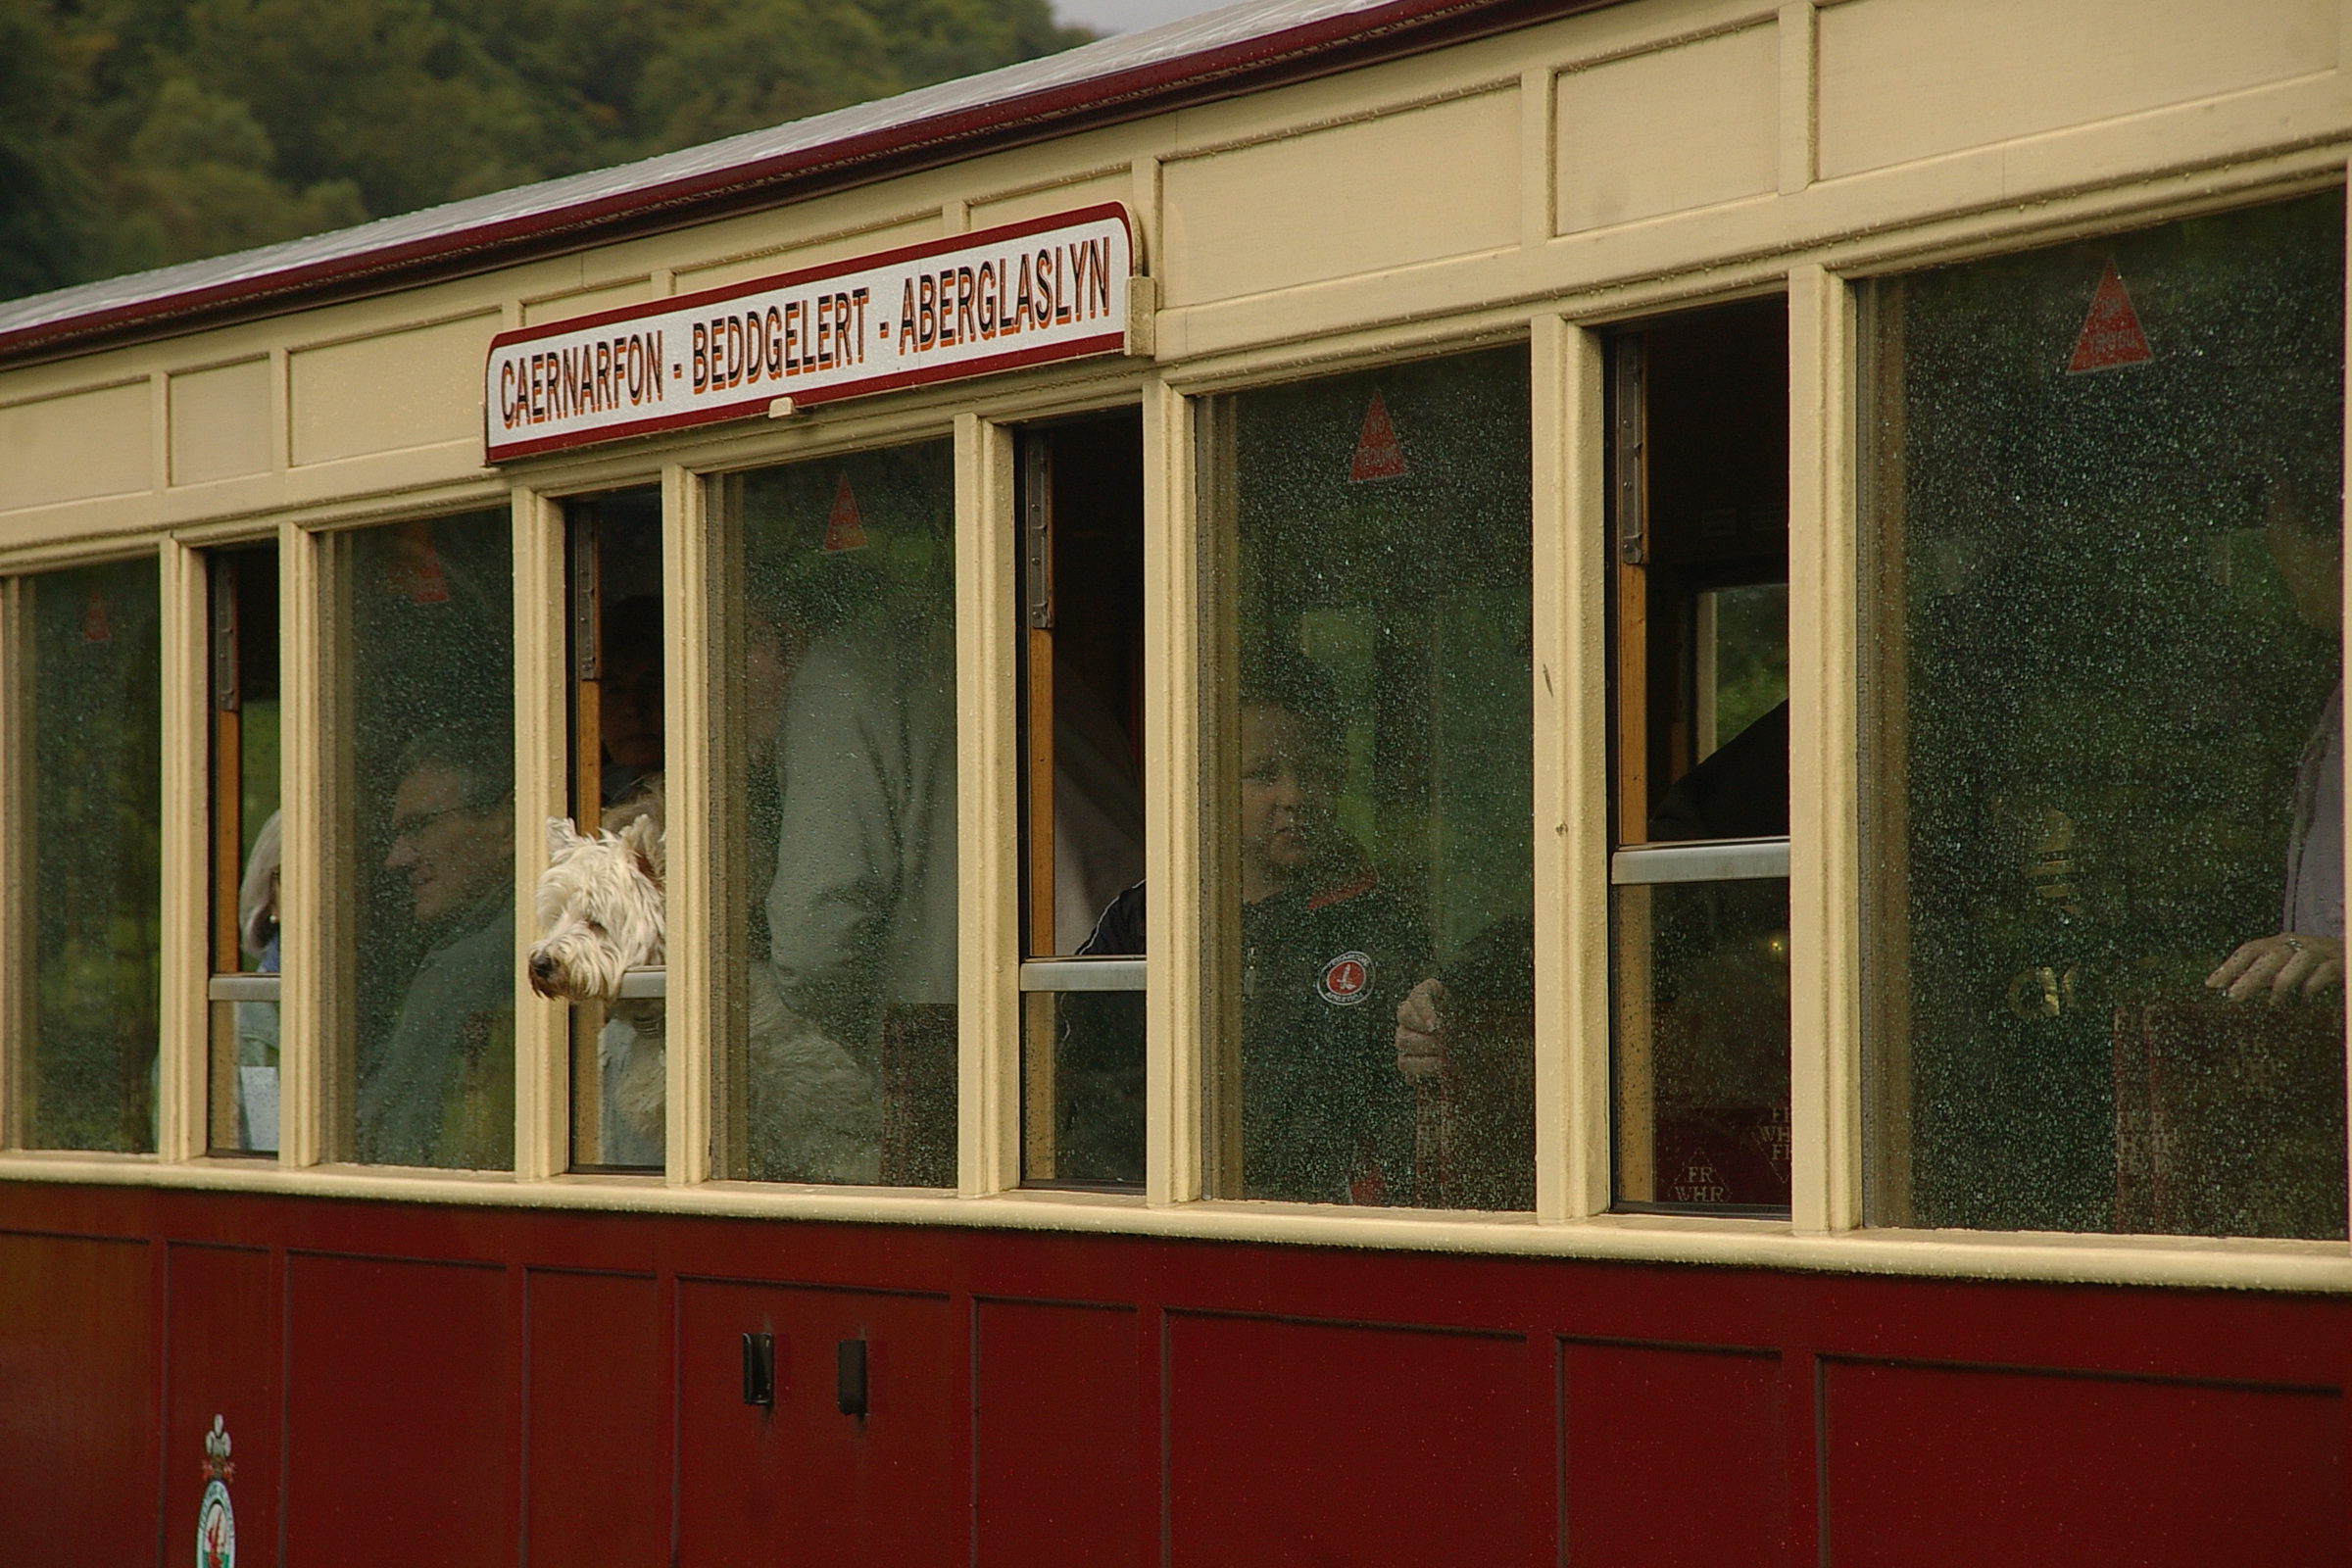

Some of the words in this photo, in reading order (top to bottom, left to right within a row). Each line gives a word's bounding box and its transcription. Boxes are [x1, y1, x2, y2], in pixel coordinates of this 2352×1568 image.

[500, 329, 663, 430] CAERNARFON
[692, 286, 870, 395] BEDDGELERT
[899, 236, 1110, 356] ABERGLASLYN
[1688, 1166, 1714, 1183] FR
[1675, 1186, 1725, 1202] WHR
